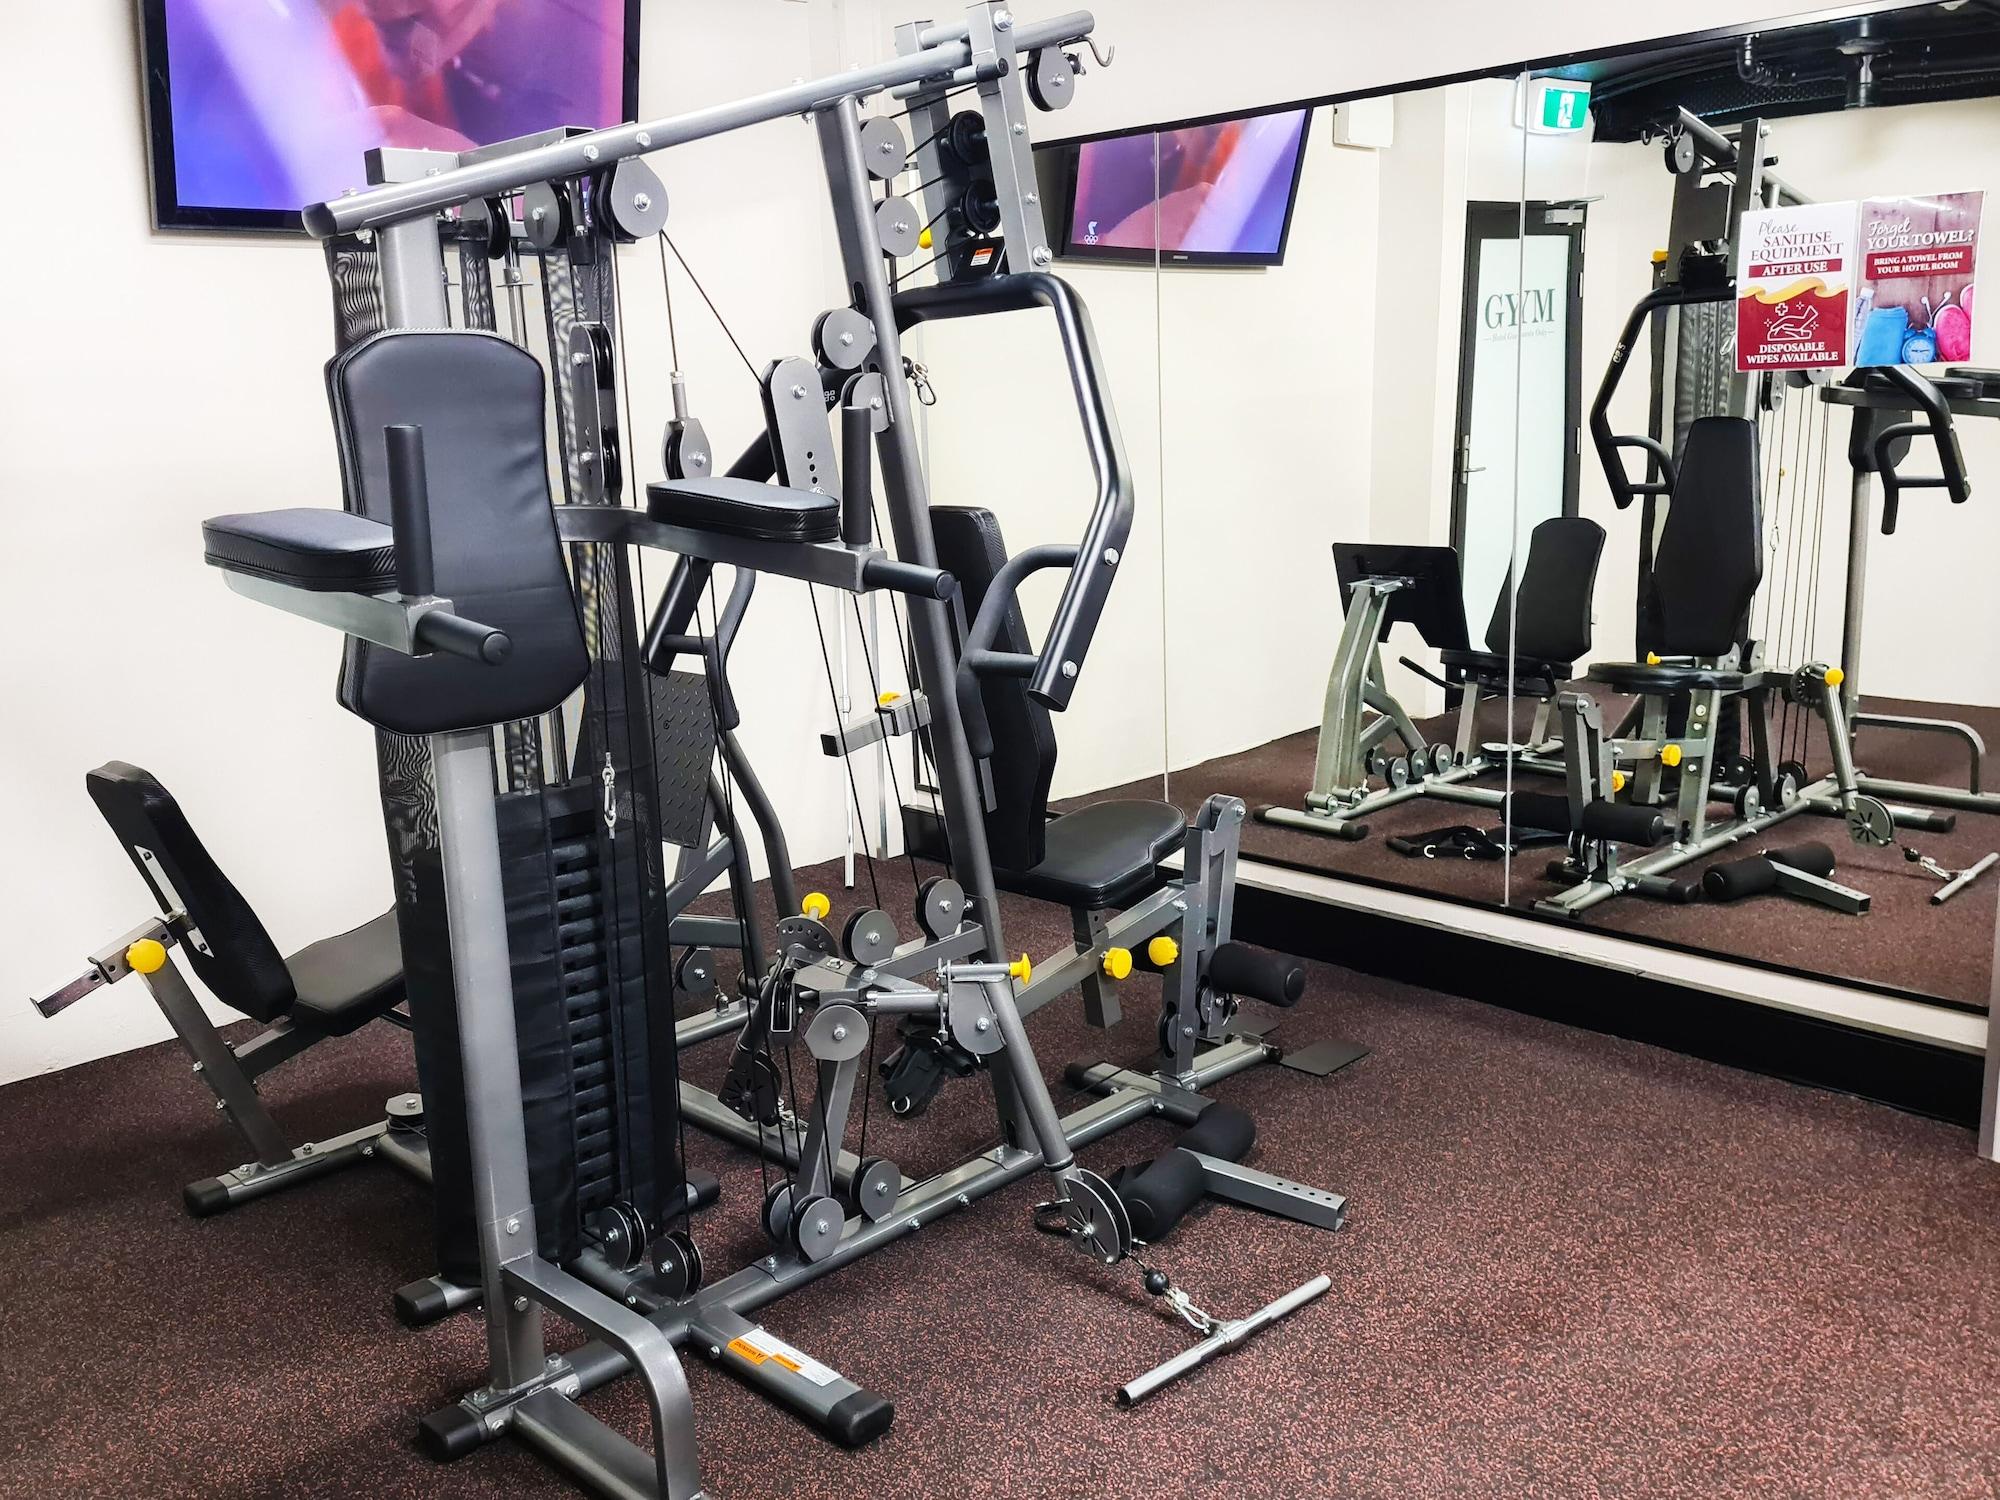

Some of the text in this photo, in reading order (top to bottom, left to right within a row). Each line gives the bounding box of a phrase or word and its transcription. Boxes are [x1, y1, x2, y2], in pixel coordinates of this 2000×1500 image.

[1758, 219, 1798, 235] Please
[1763, 231, 1832, 248] SANITISE
[1867, 229, 1975, 250] YOUR TOWEL?
[1751, 243, 1844, 262] EQUIPMENT
[1874, 257, 1899, 265] BRING
[1908, 254, 1937, 262] TOWEL
[1938, 252, 1963, 260] FROM
[1762, 261, 1829, 277] AFTER USE
[1877, 261, 1958, 274] YOUR HOTEL ROOM
[1485, 288, 1556, 329] GYM
[1759, 341, 1826, 354] DISPOSABLE
[1746, 351, 1839, 364] WIPES AVAILABLE
